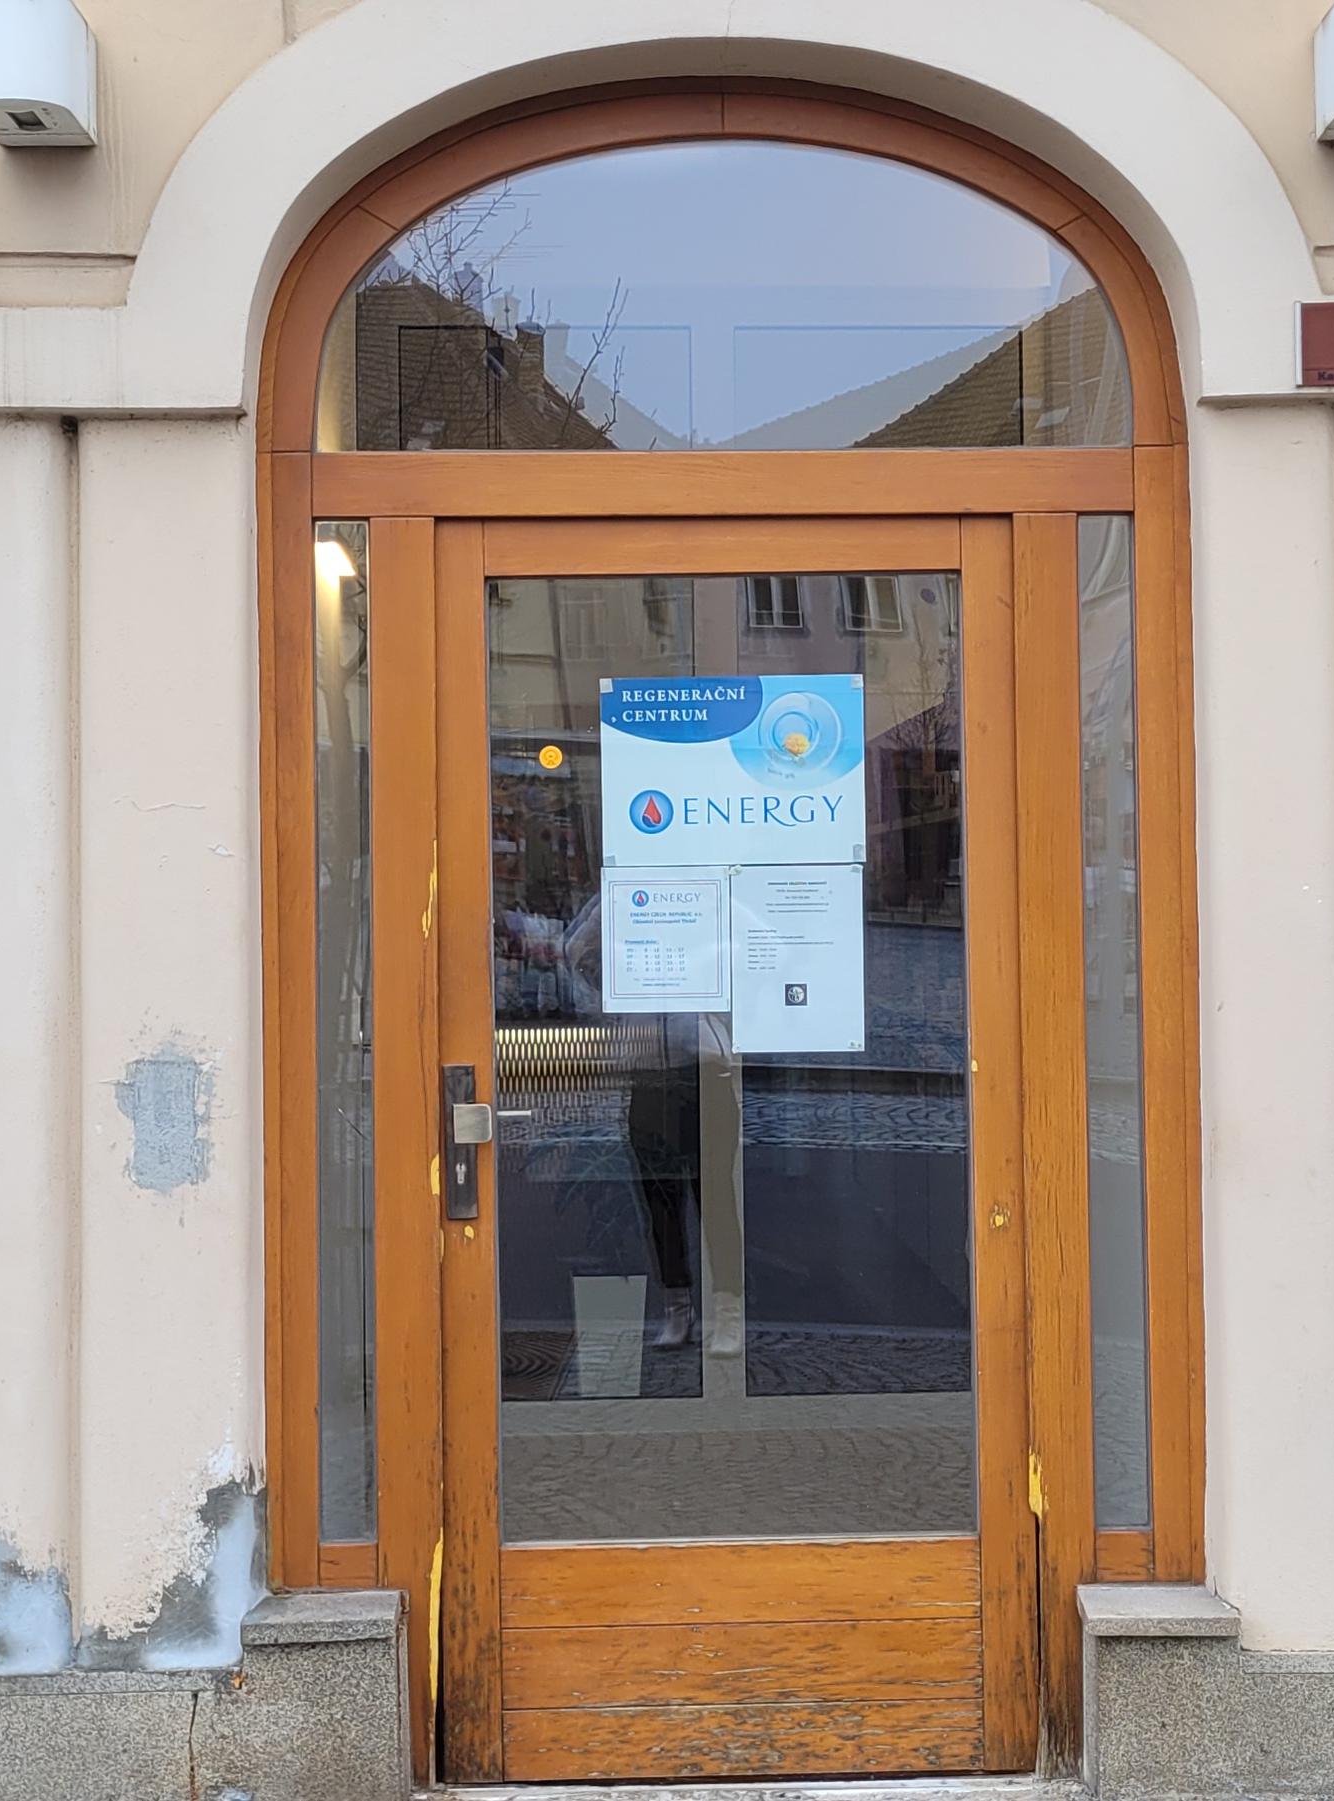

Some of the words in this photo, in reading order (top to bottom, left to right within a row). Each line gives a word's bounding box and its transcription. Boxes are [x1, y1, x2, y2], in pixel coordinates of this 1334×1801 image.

[622, 685, 746, 702] REGENERAČNÍ
[622, 708, 708, 723] CENTRUM
[683, 795, 843, 827] ENERGY
[653, 893, 701, 903] ENERGY
